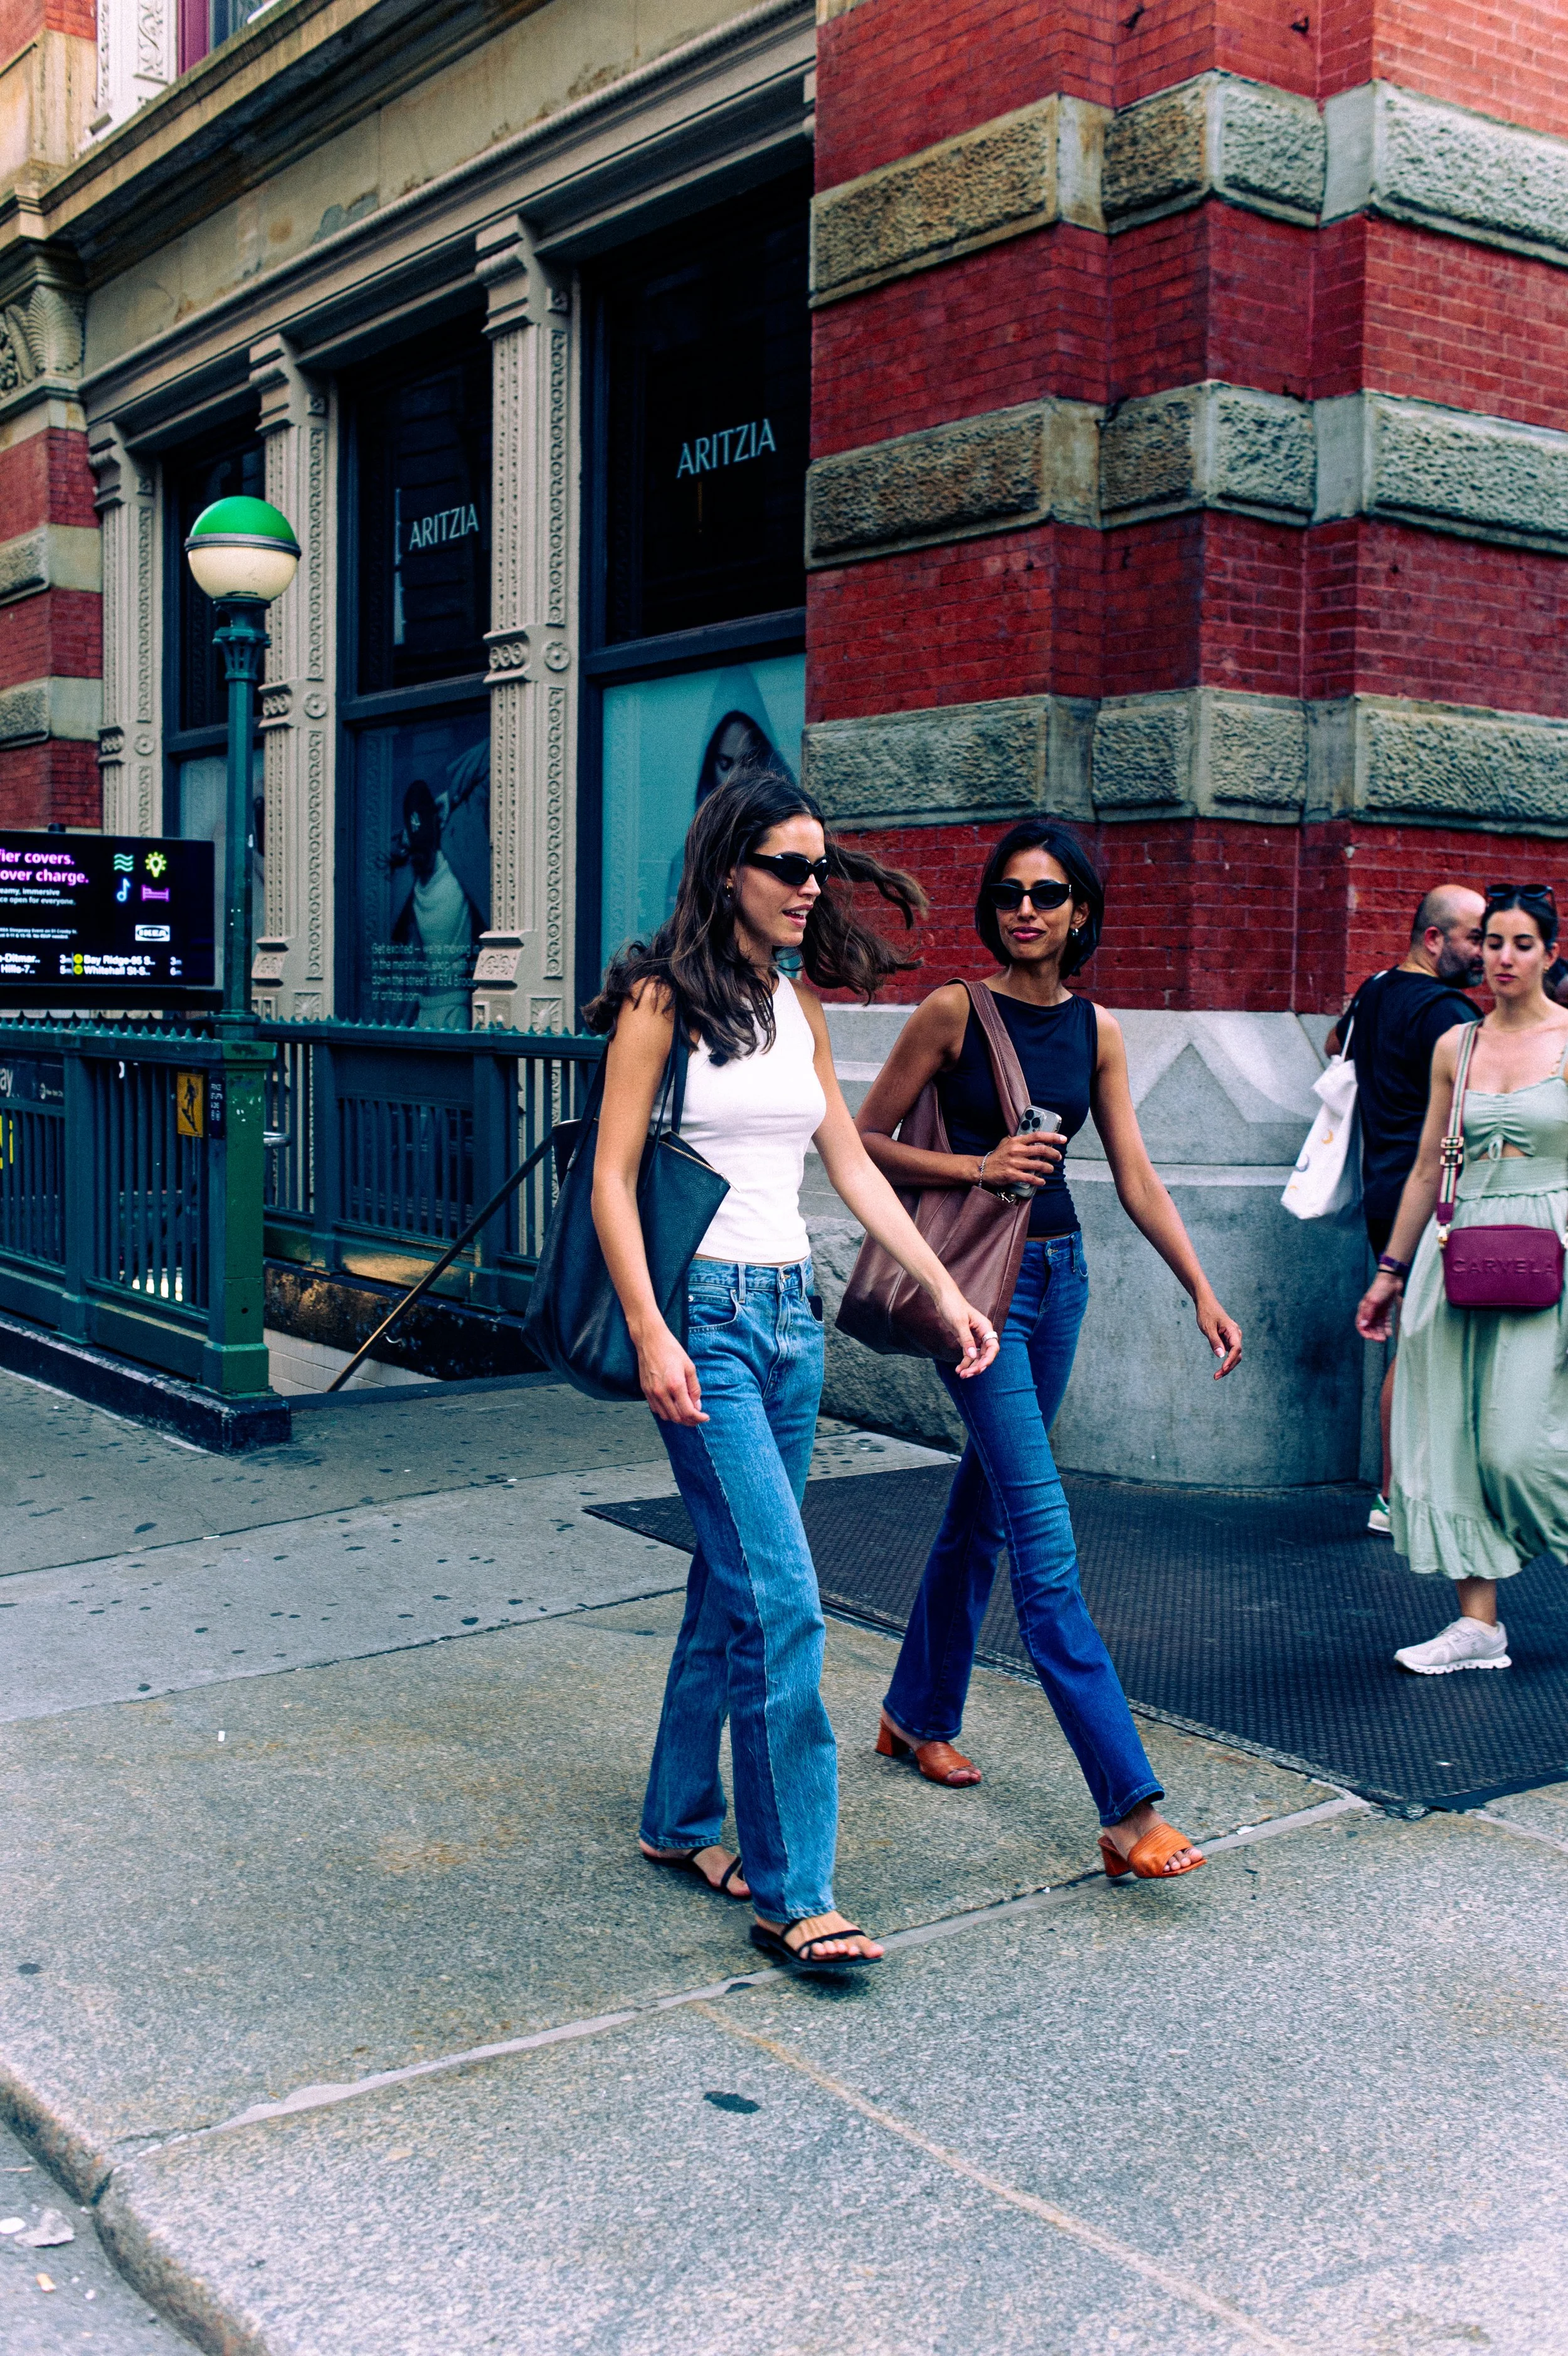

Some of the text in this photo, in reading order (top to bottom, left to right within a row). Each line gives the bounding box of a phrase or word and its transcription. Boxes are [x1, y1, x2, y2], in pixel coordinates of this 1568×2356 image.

[677, 418, 776, 479] ARITZIA
[409, 503, 479, 551] ARITZIA
[24, 853, 75, 864] covers.
[36, 869, 89, 886] charge.
[371, 943, 385, 954] Get
[386, 943, 413, 954] excited
[83, 955, 102, 966] Bay
[83, 965, 125, 975] Whitehall
[1452, 1257, 1556, 1274] CARVELA
